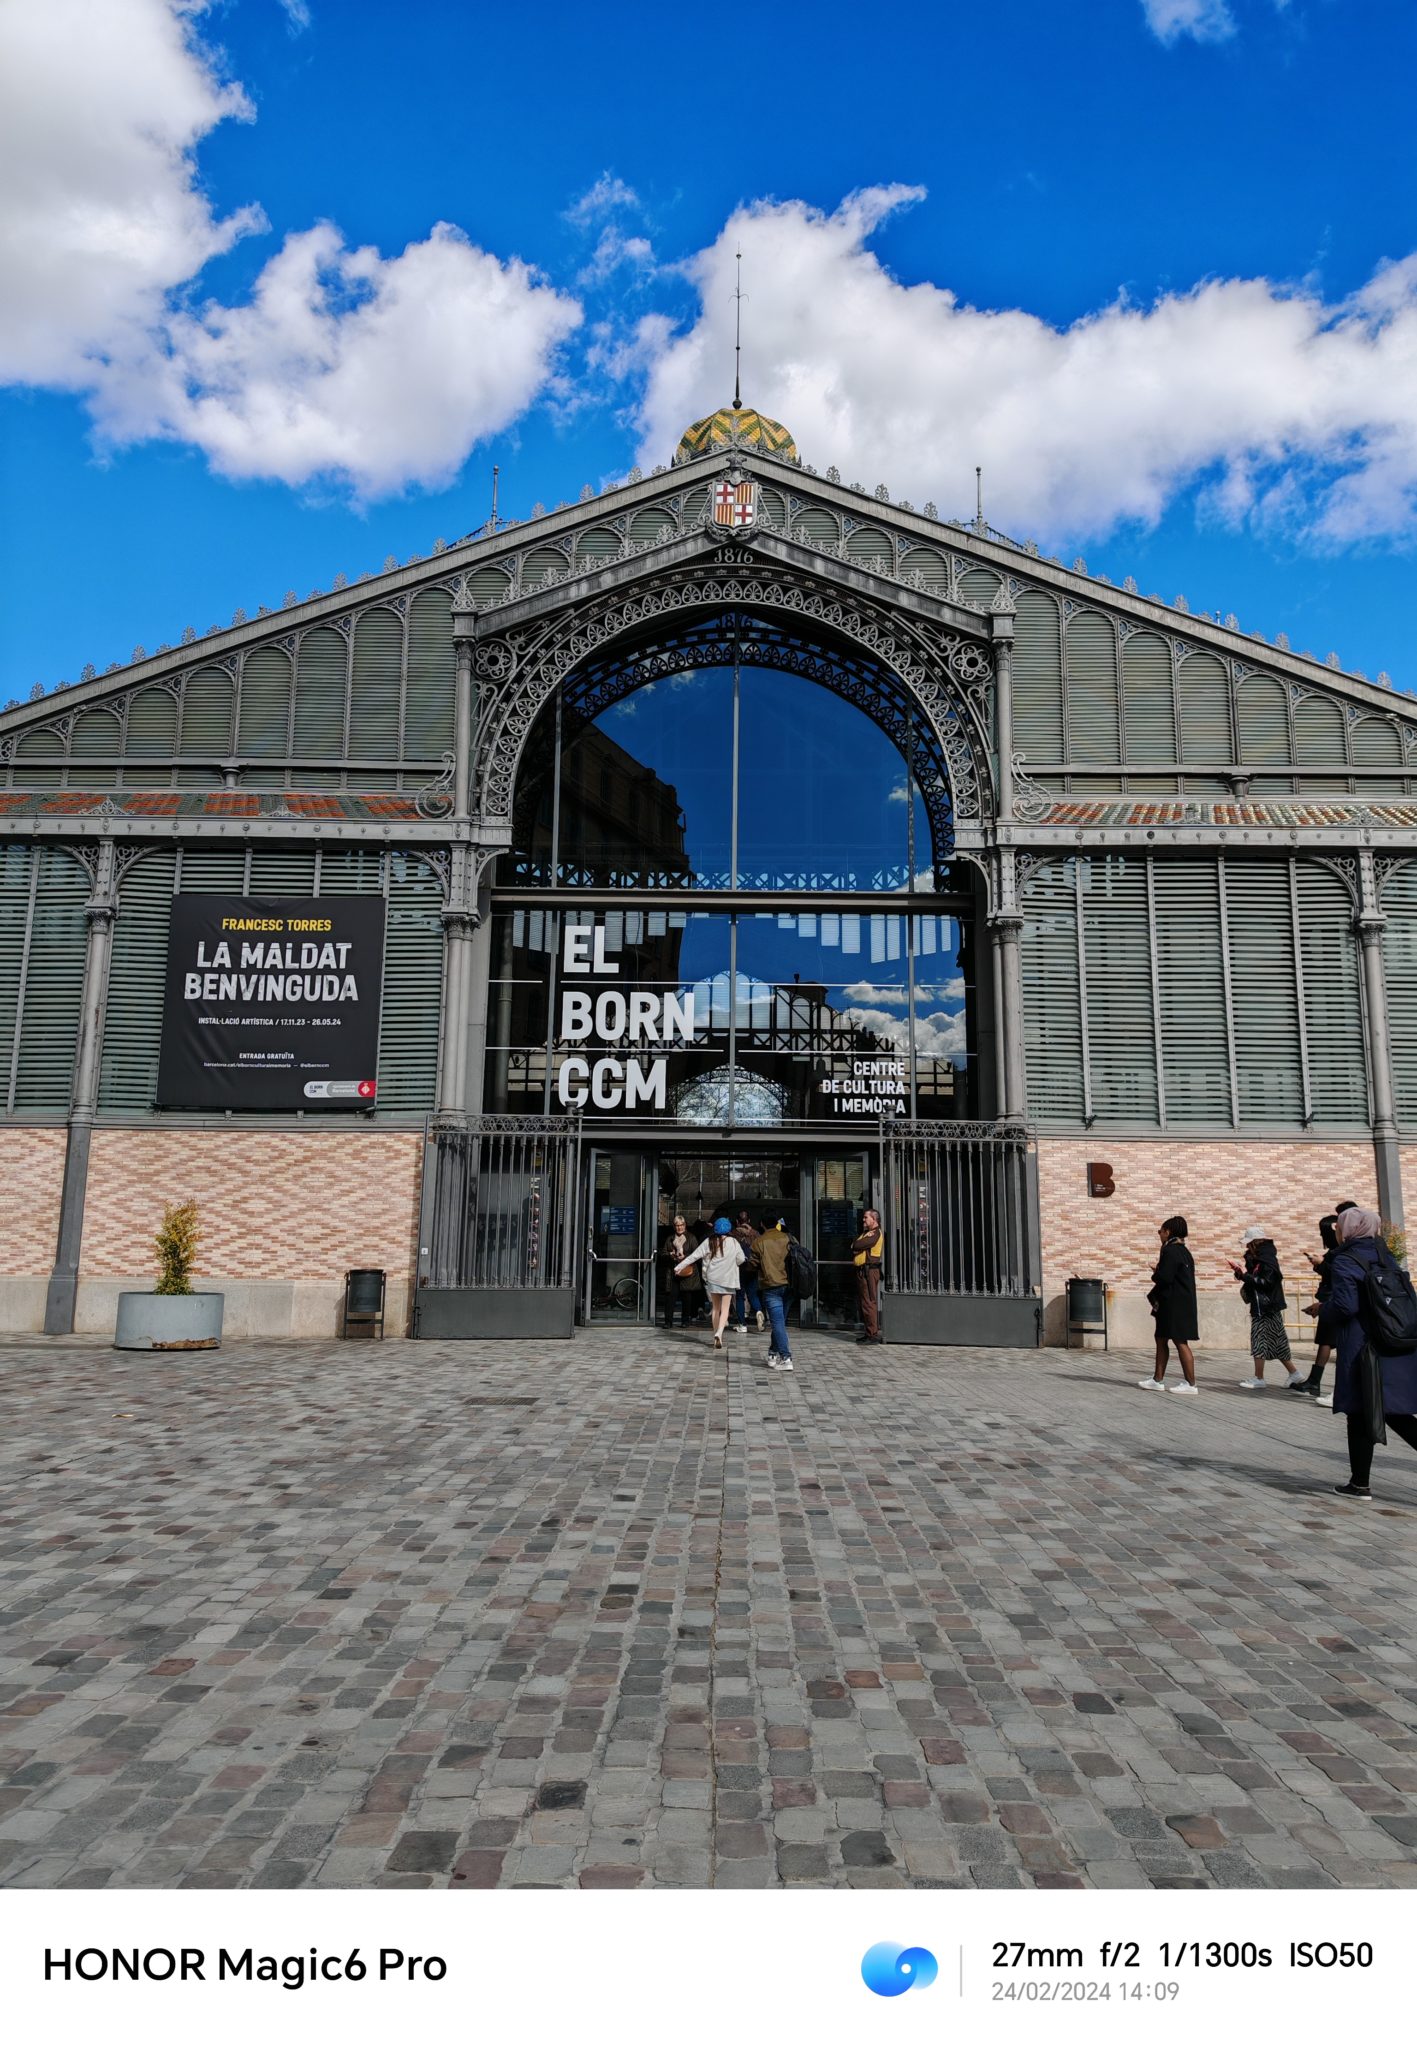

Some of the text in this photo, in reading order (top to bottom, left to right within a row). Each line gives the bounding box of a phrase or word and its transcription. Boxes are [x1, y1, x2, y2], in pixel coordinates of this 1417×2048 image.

[714, 547, 754, 564] 1876
[222, 917, 332, 932] FRANCESC TORRES
[196, 941, 352, 969] LA MALDAT
[563, 925, 619, 973] EL
[184, 973, 359, 1002] BENVINGUDA
[241, 1017, 274, 1026] ARTÍSTICA
[281, 1018, 306, 1026] 17.11.23
[312, 1018, 341, 1026] 26.05.24
[561, 991, 695, 1042] BORN
[853, 1061, 905, 1076] CENTRE
[558, 1058, 667, 1110] CCM
[822, 1079, 905, 1094] DE CULTURA
[834, 1098, 838, 1112] I
[1087, 1163, 1115, 1198] B
